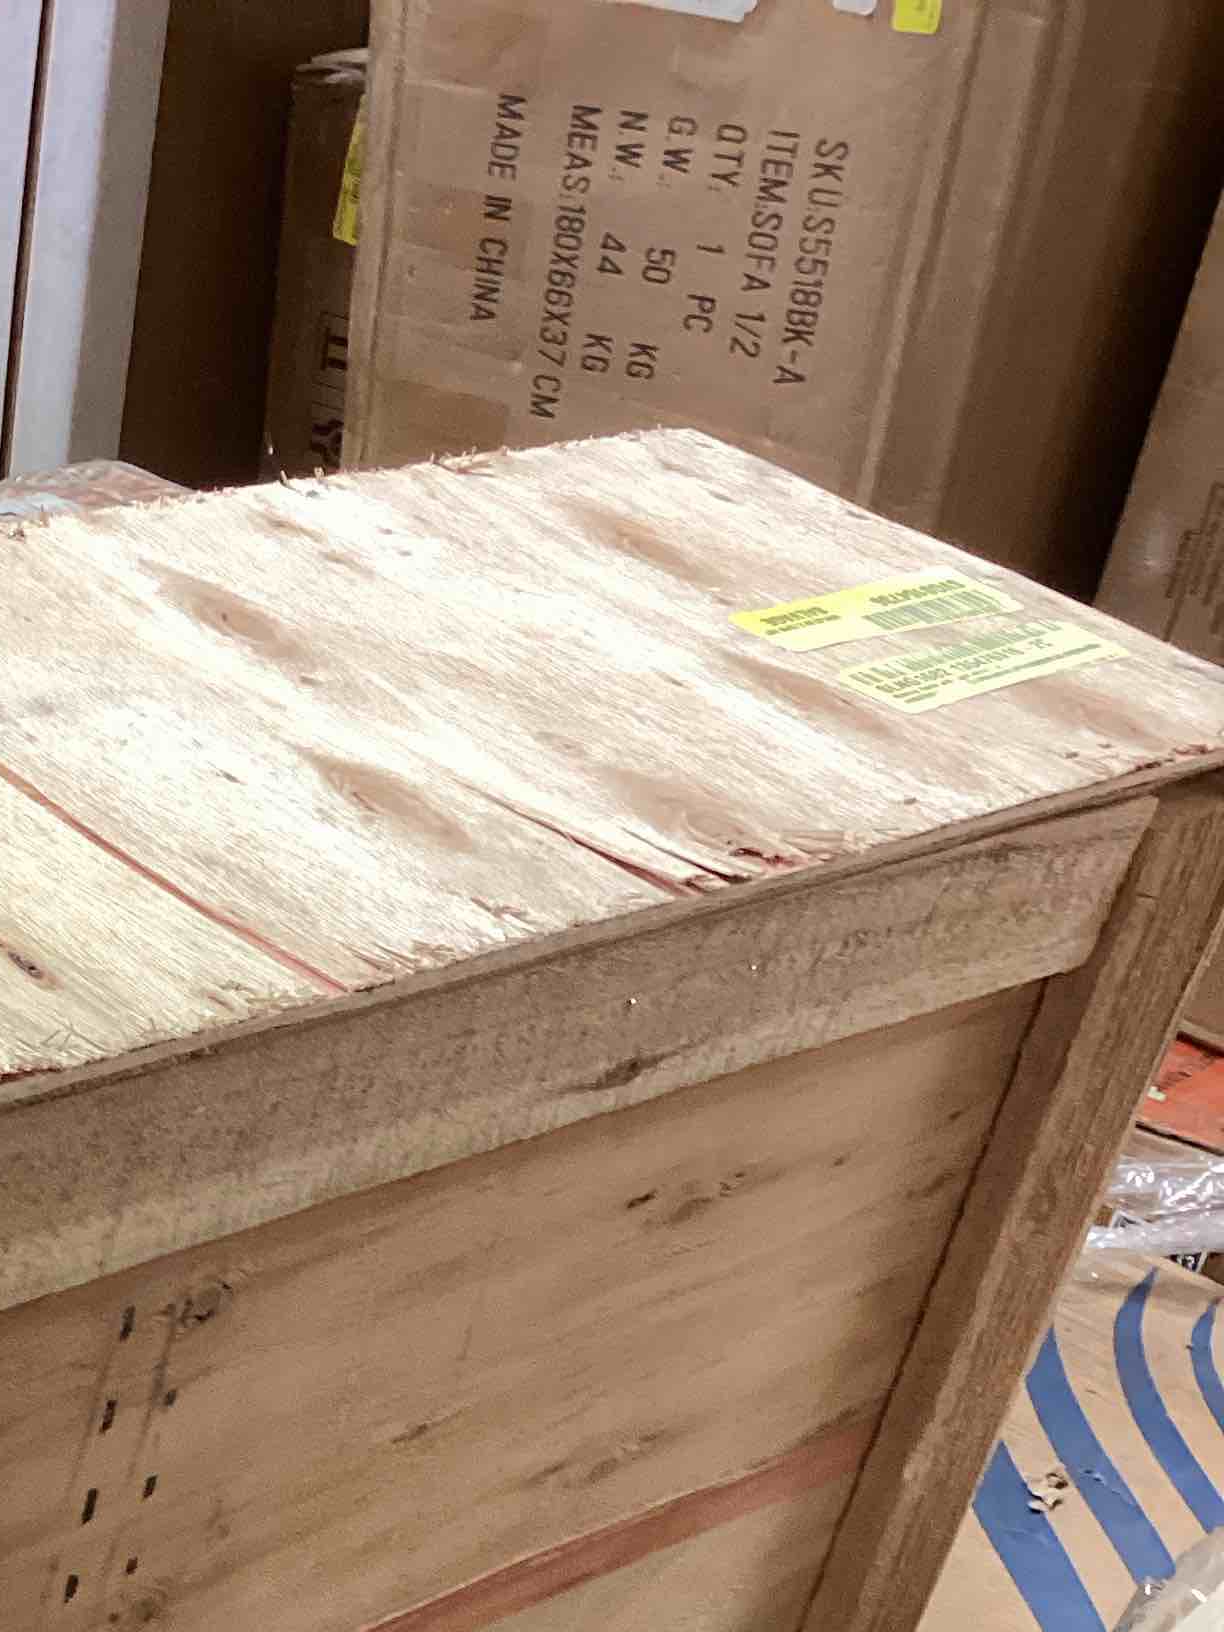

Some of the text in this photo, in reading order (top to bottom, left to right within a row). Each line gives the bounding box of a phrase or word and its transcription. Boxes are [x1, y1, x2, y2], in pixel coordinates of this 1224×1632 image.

[469, 92, 528, 322] MADE IN CHINA
[595, 231, 628, 277] 44
[642, 246, 676, 285] 50
[695, 243, 725, 256] 1
[682, 293, 718, 334] PC
[579, 332, 615, 374] KG
[728, 311, 766, 359] 1/2
[625, 341, 661, 380] KG
[529, 373, 562, 419] CM
